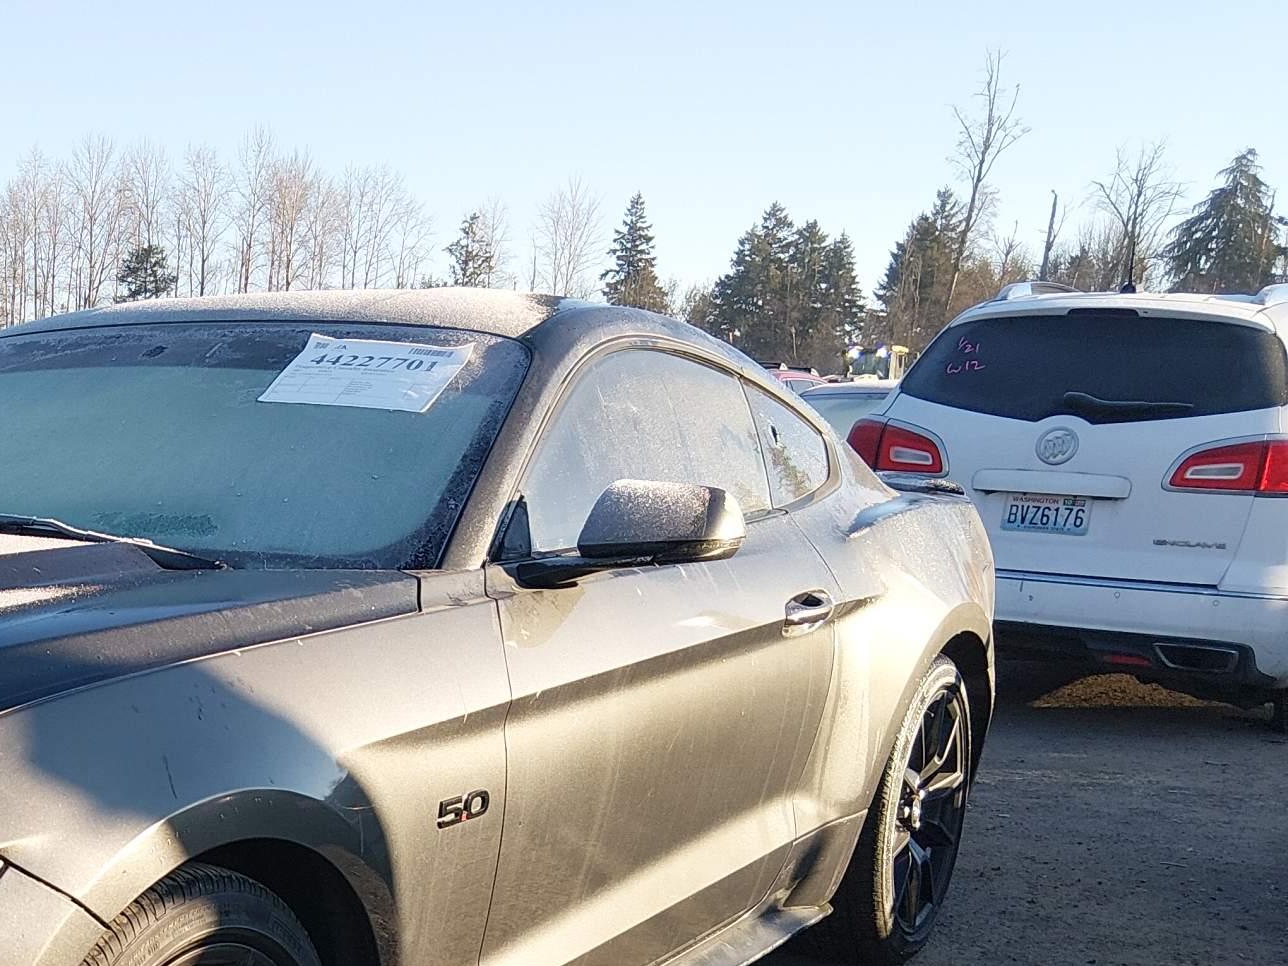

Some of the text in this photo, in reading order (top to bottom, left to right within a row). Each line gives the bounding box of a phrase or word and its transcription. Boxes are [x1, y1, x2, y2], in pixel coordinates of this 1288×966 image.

[310, 353, 438, 372] 44227701
[1012, 495, 1059, 505] WASHINGTON
[1007, 504, 1086, 528] BVZ6176
[1152, 539, 1226, 550] ENCLAVE
